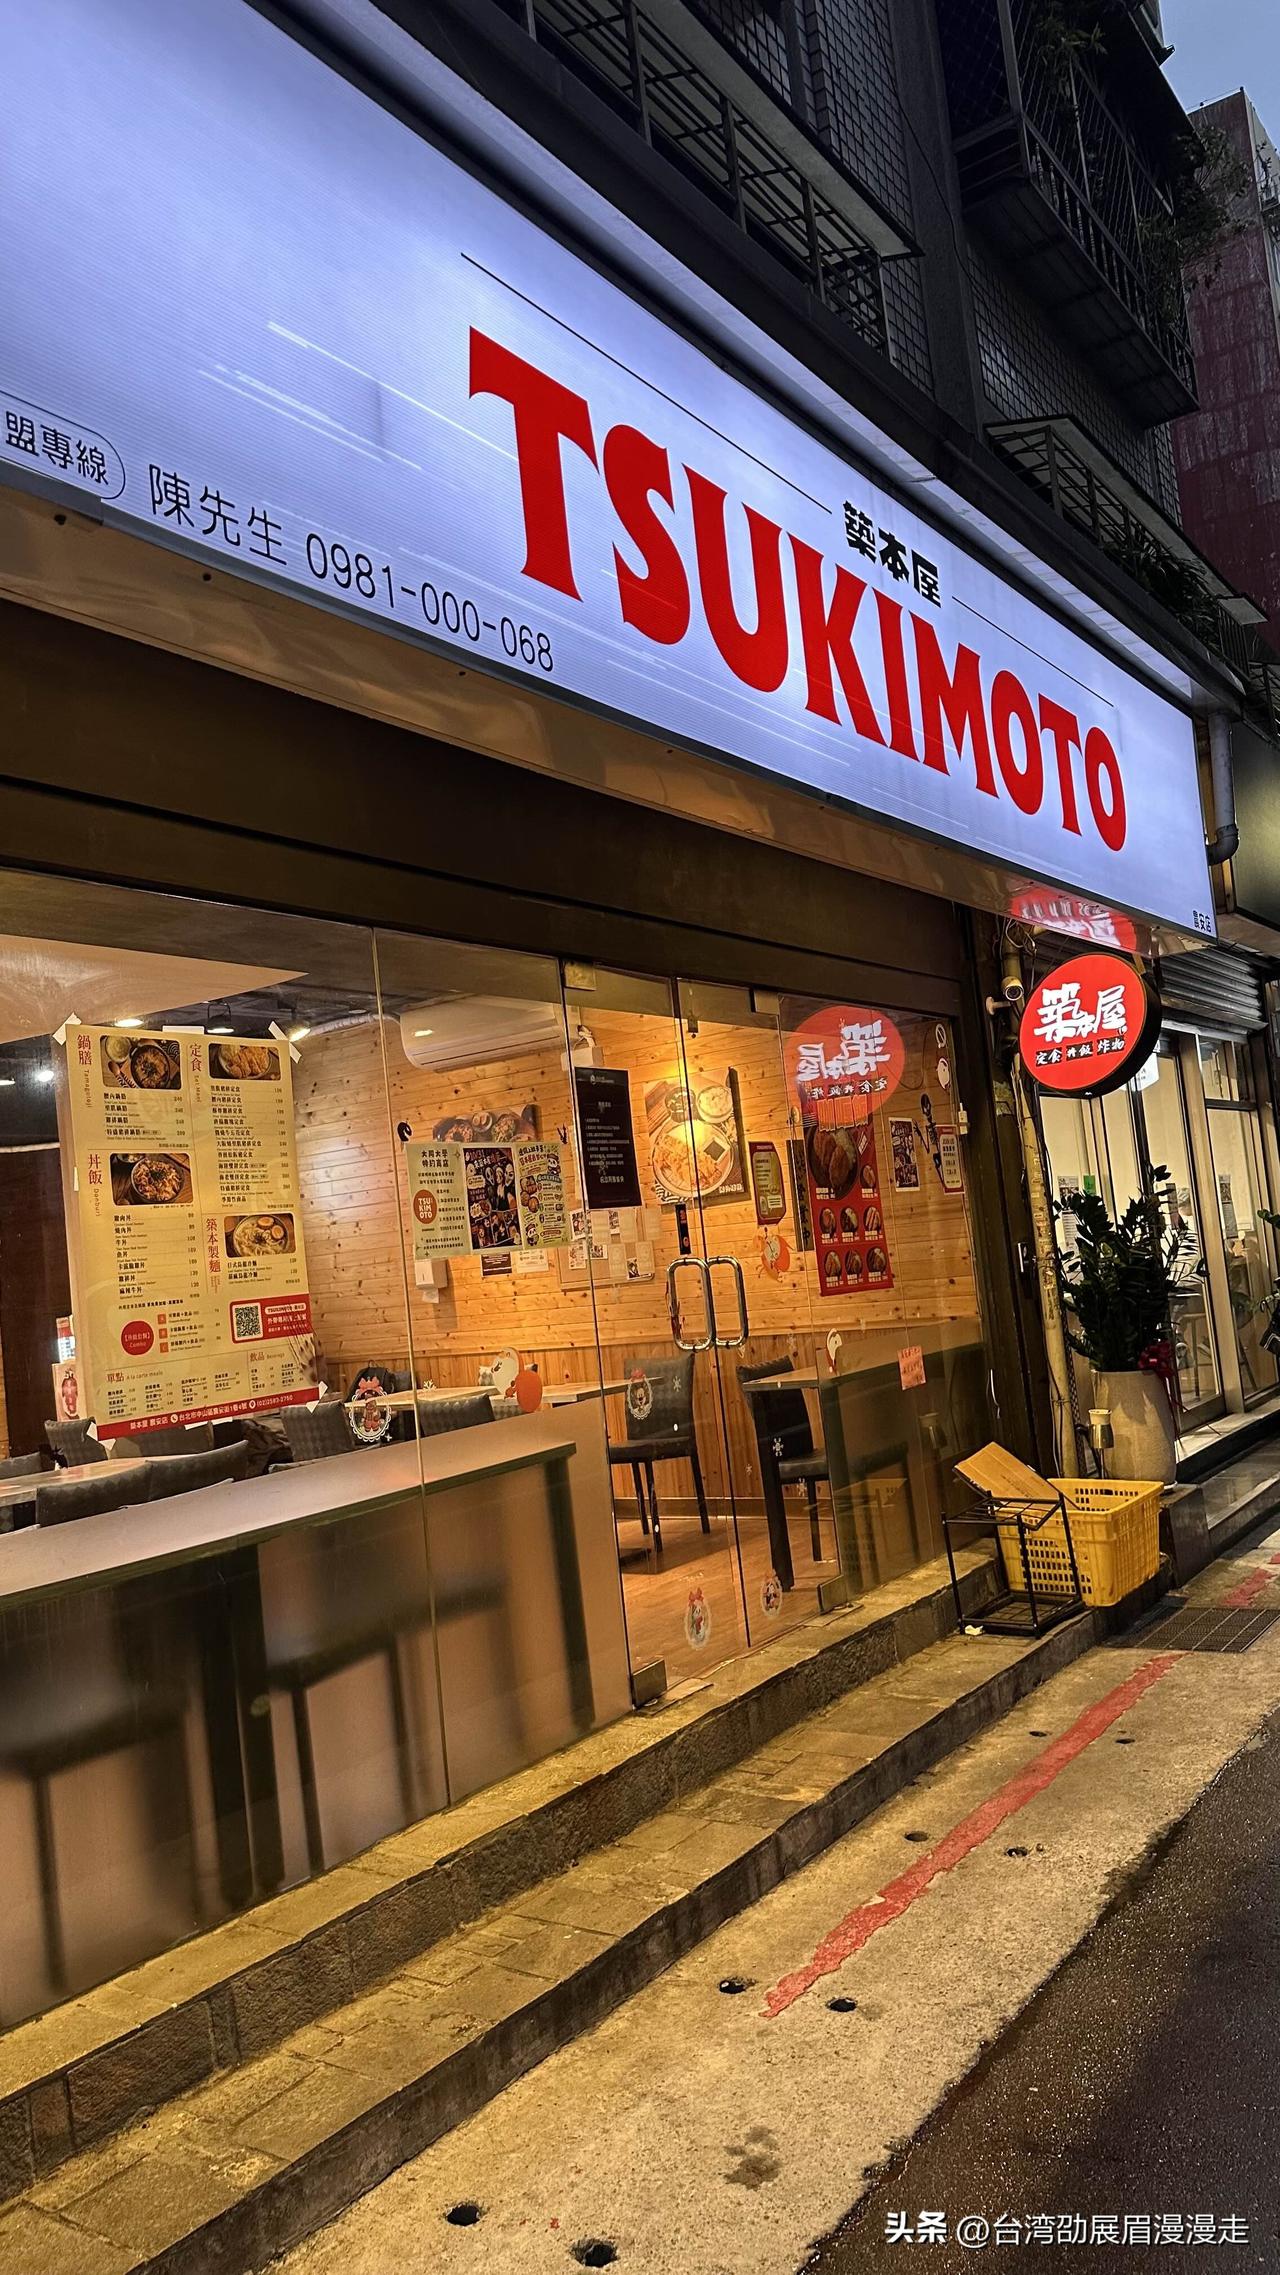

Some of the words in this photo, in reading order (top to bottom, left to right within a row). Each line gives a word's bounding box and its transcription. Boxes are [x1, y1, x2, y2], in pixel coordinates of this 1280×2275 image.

[5, 410, 109, 486] 盟專線
[149, 463, 288, 566] 陳先生
[306, 532, 554, 673] 0981-000-068
[843, 500, 941, 608] 築本屋
[469, 325, 1127, 852] TSUKIMOTO
[1034, 983, 1128, 1043] 築本屋
[190, 1043, 202, 1072] 定食
[88, 1154, 103, 1186] 丼飯
